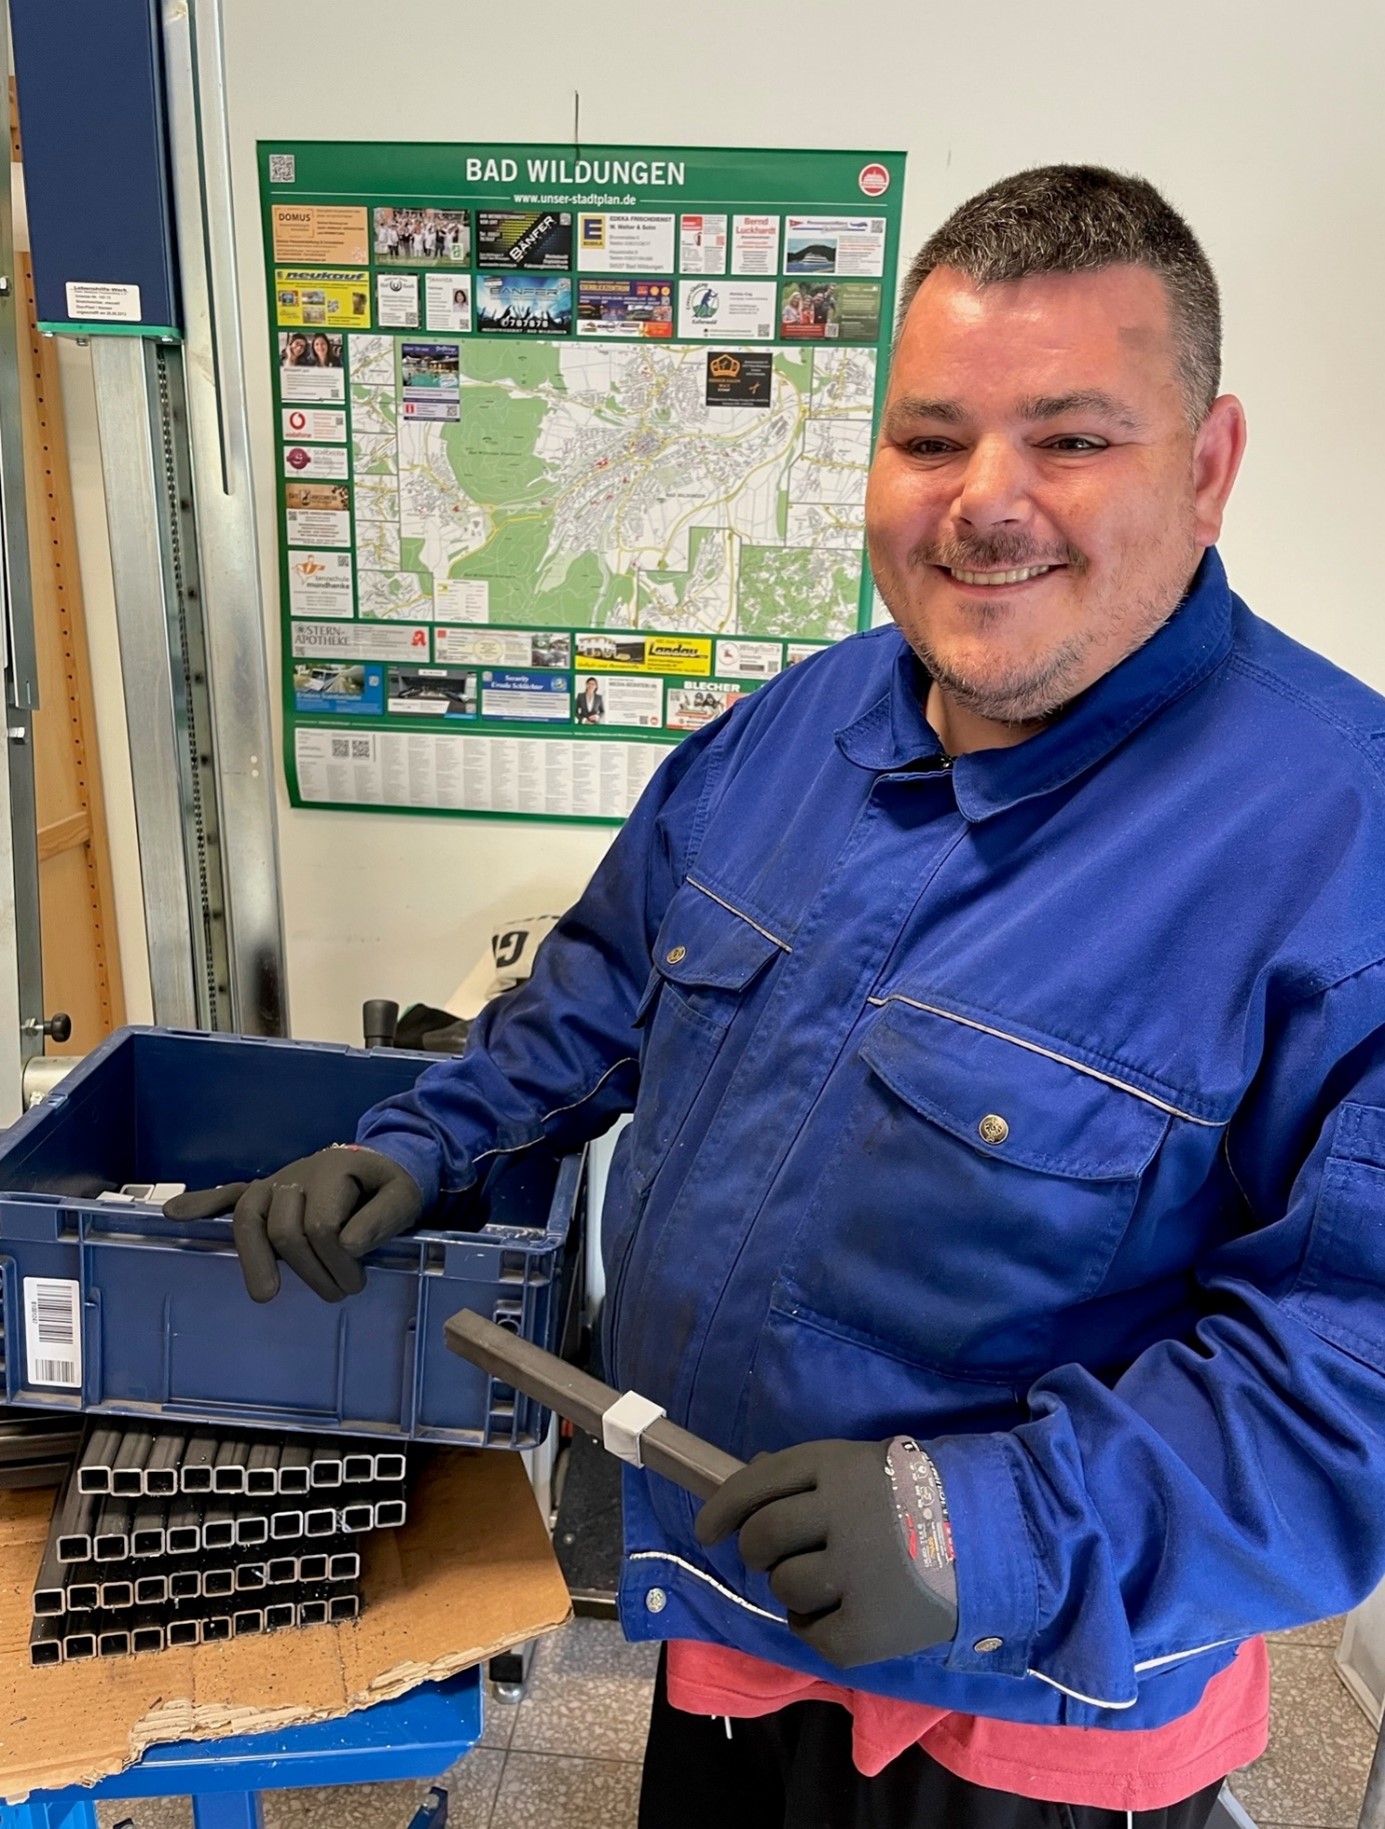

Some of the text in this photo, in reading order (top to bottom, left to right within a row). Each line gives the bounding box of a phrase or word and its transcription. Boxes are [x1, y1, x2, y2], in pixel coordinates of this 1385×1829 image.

[466, 158, 685, 185] BAD WILDUNGEN
[514, 193, 636, 206] www.unser-stadtplan.de
[278, 213, 311, 222] DOMUS
[744, 217, 769, 225] Bernd
[736, 226, 776, 234] Luckhardt
[285, 272, 365, 280] neukauf
[294, 634, 351, 646] APOTHEKE
[684, 681, 741, 692] BLECHER
